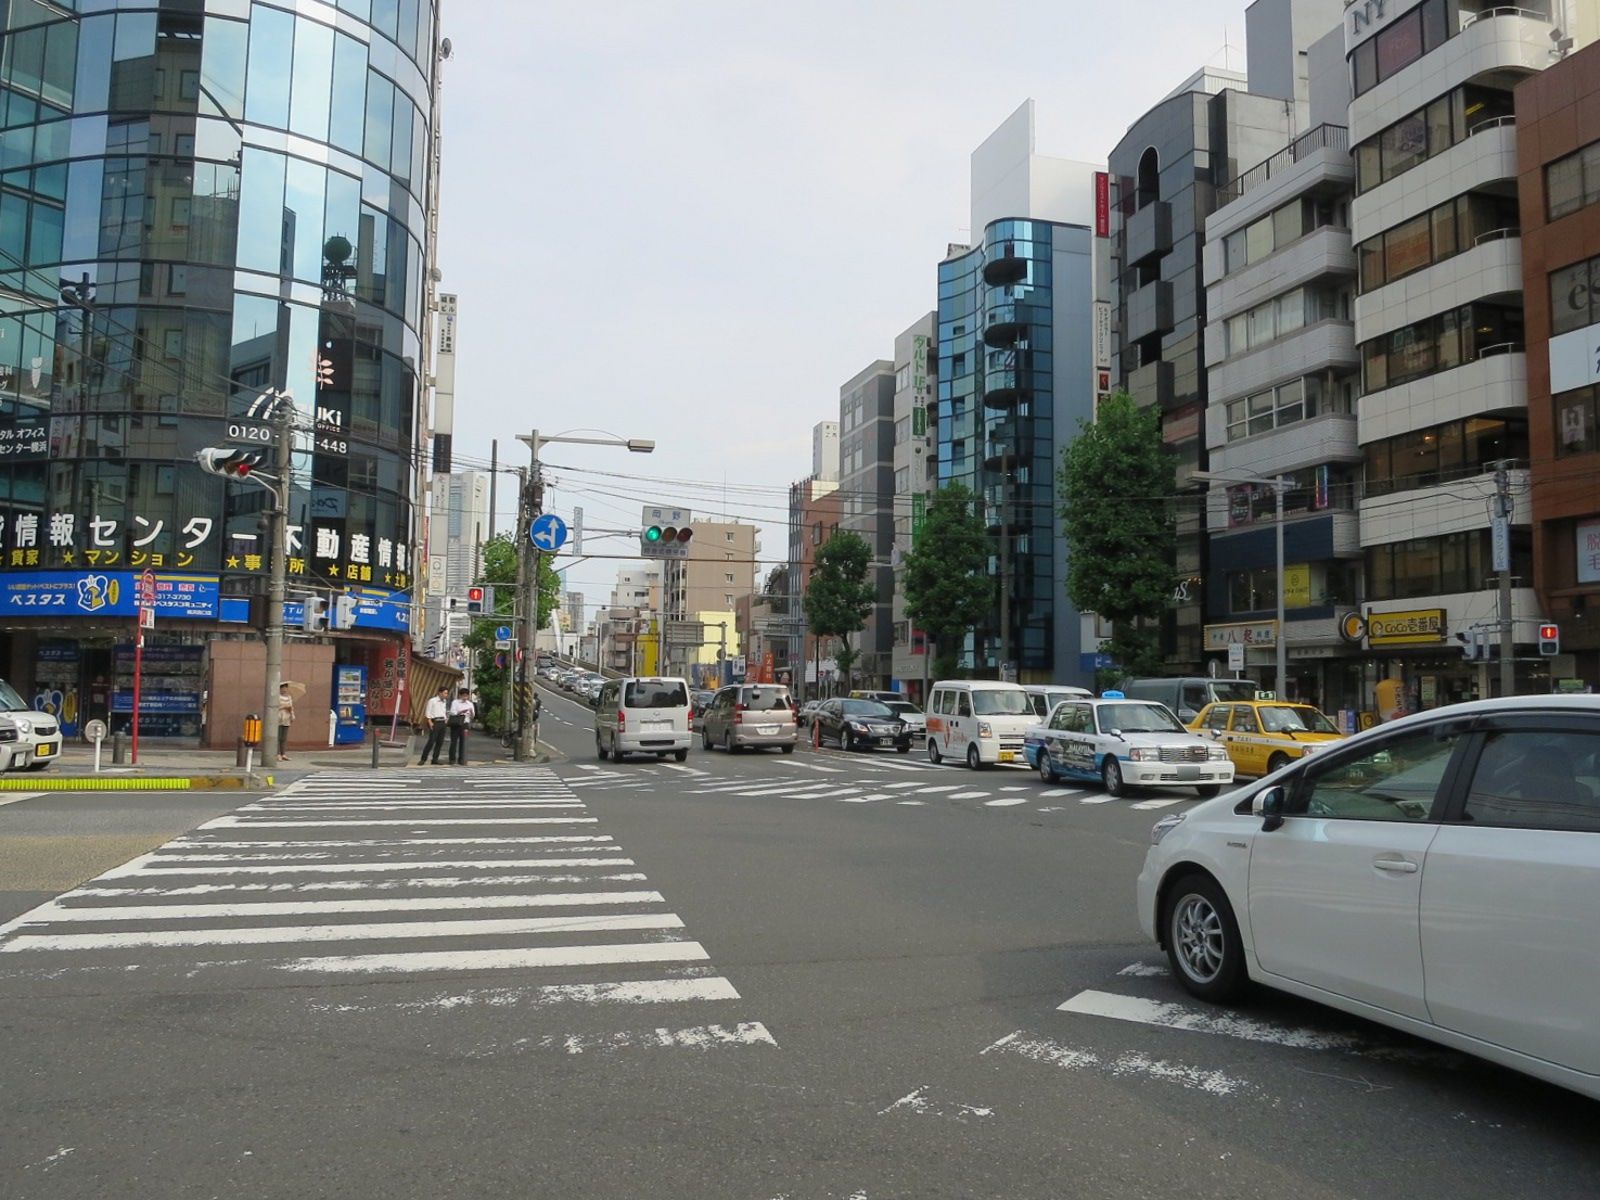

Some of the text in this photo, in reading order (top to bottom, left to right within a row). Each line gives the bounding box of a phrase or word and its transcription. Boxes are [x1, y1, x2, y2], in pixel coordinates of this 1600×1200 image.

[244, 554, 305, 574] 事所
[10, 594, 66, 605] ベスタス
